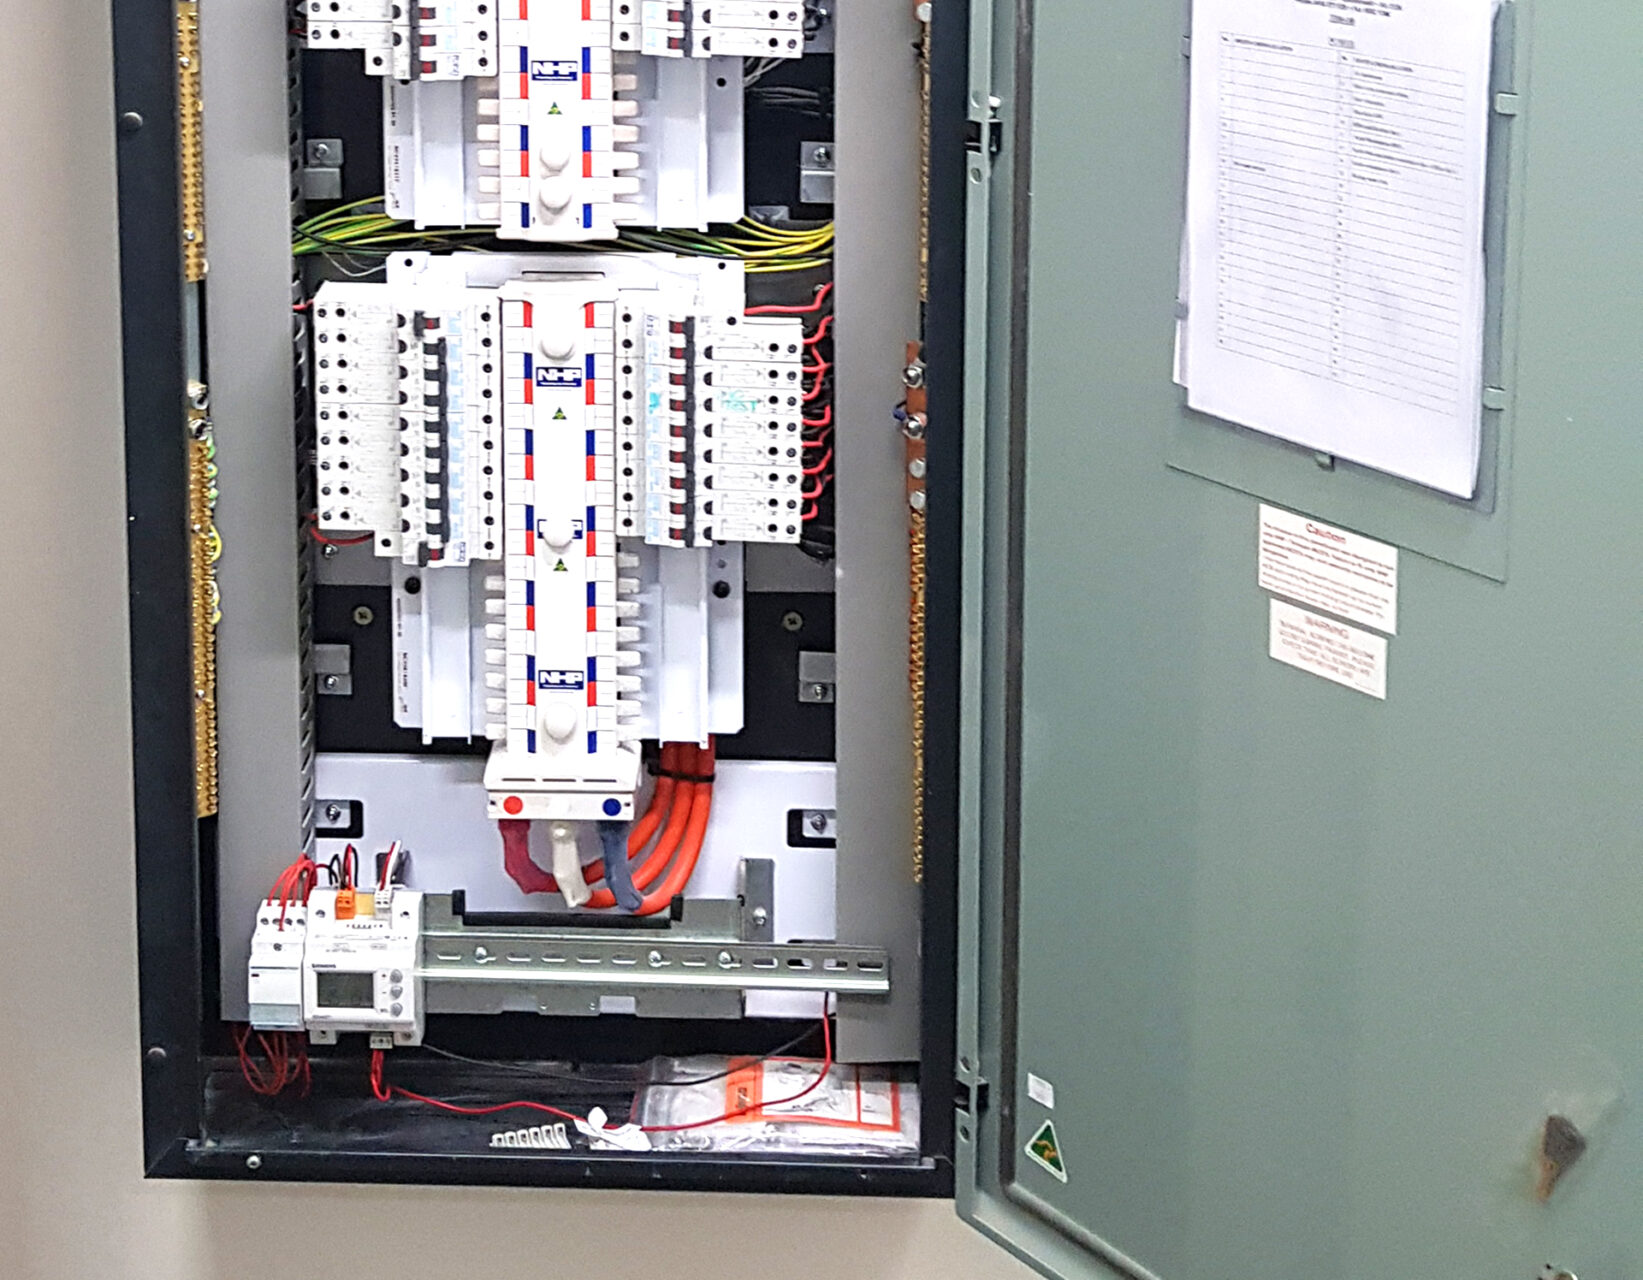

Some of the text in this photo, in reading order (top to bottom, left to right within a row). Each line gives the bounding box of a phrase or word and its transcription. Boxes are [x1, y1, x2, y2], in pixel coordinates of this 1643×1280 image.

[532, 61, 578, 76] NHP
[537, 368, 582, 382] NHP
[539, 671, 584, 684] NHP
